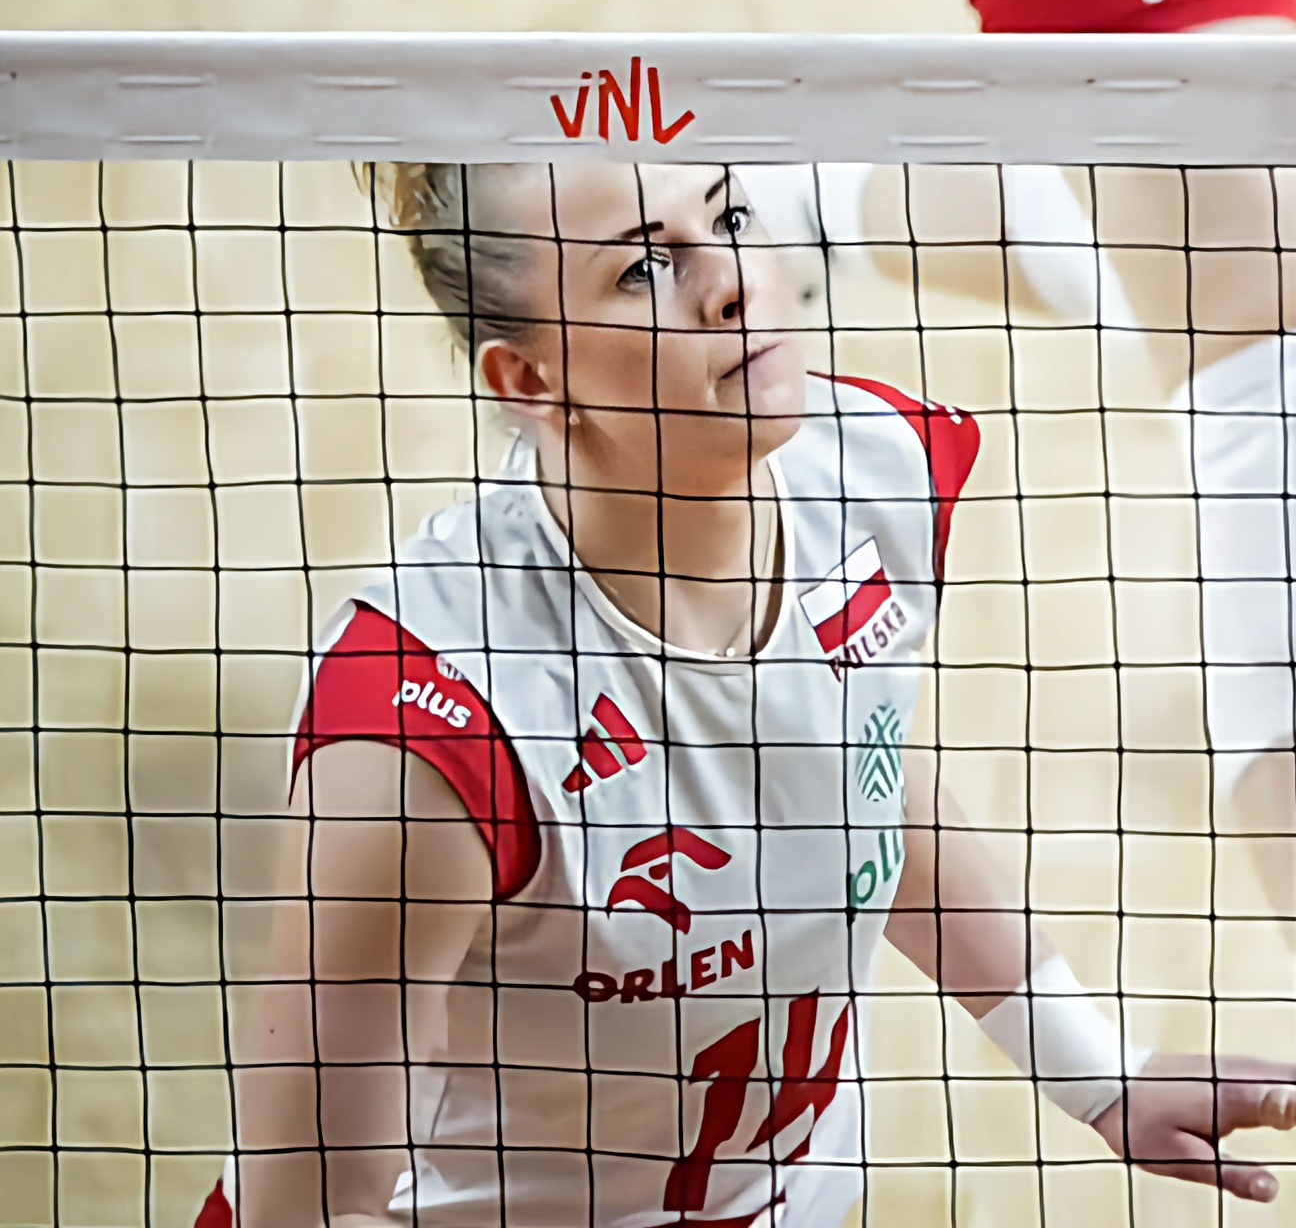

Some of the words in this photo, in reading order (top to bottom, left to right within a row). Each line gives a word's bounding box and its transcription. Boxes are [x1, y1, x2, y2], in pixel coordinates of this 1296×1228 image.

[551, 56, 696, 145] VNL
[391, 679, 472, 728] plus
[573, 929, 756, 1005] ORLEN
